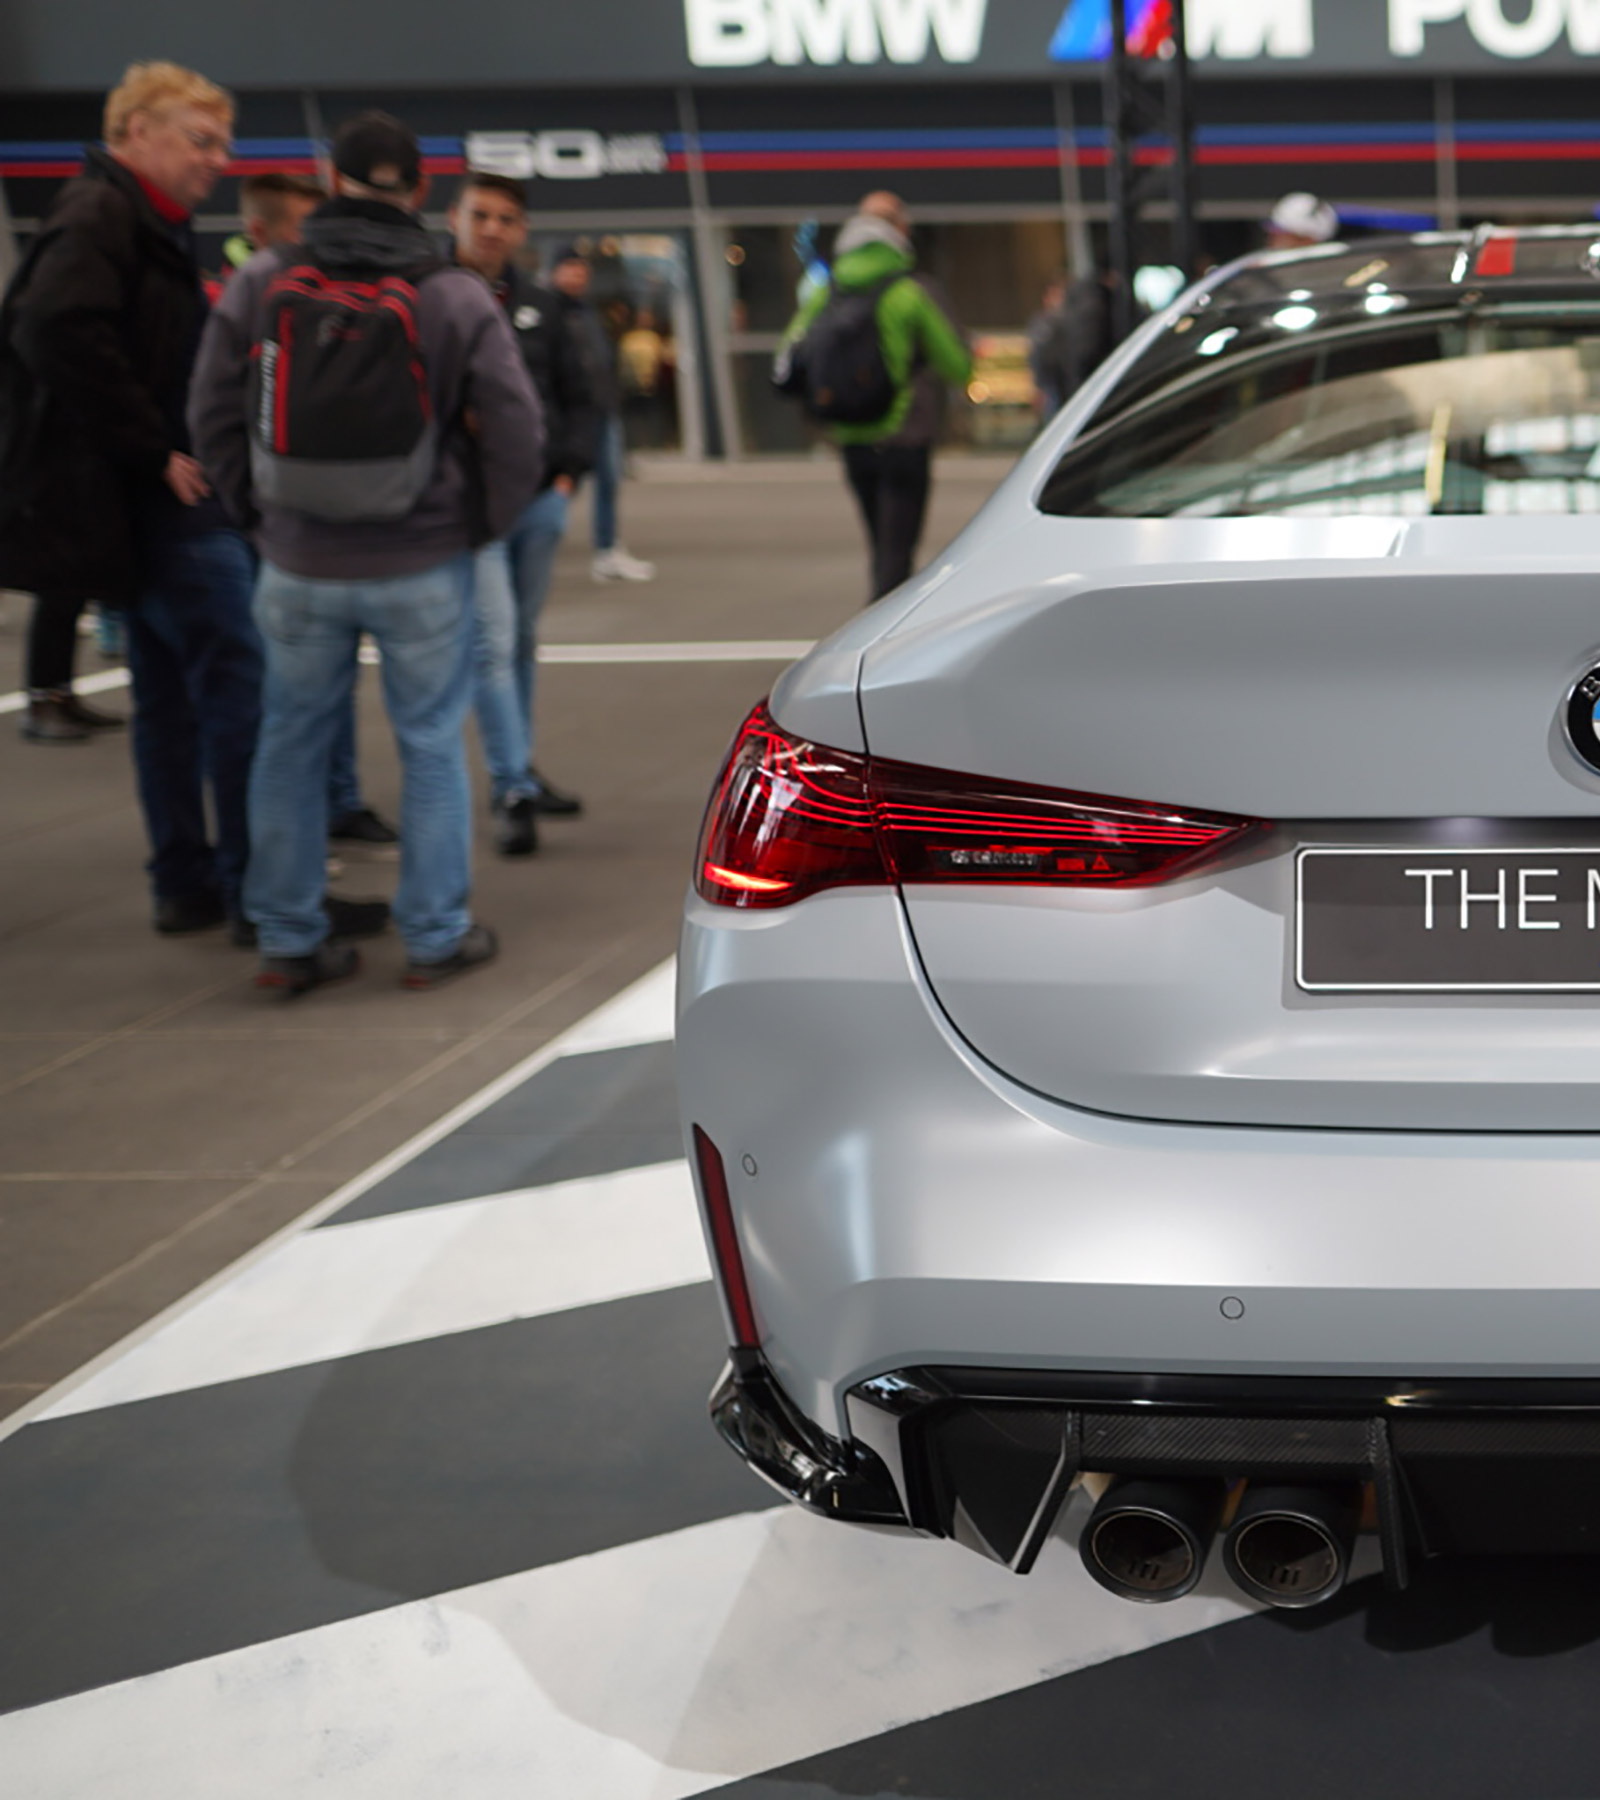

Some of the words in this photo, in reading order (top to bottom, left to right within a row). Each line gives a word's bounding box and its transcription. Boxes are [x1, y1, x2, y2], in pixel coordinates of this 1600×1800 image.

[684, 0, 987, 67] BMW
[465, 130, 604, 180] 50
[1404, 868, 1561, 930] THE
